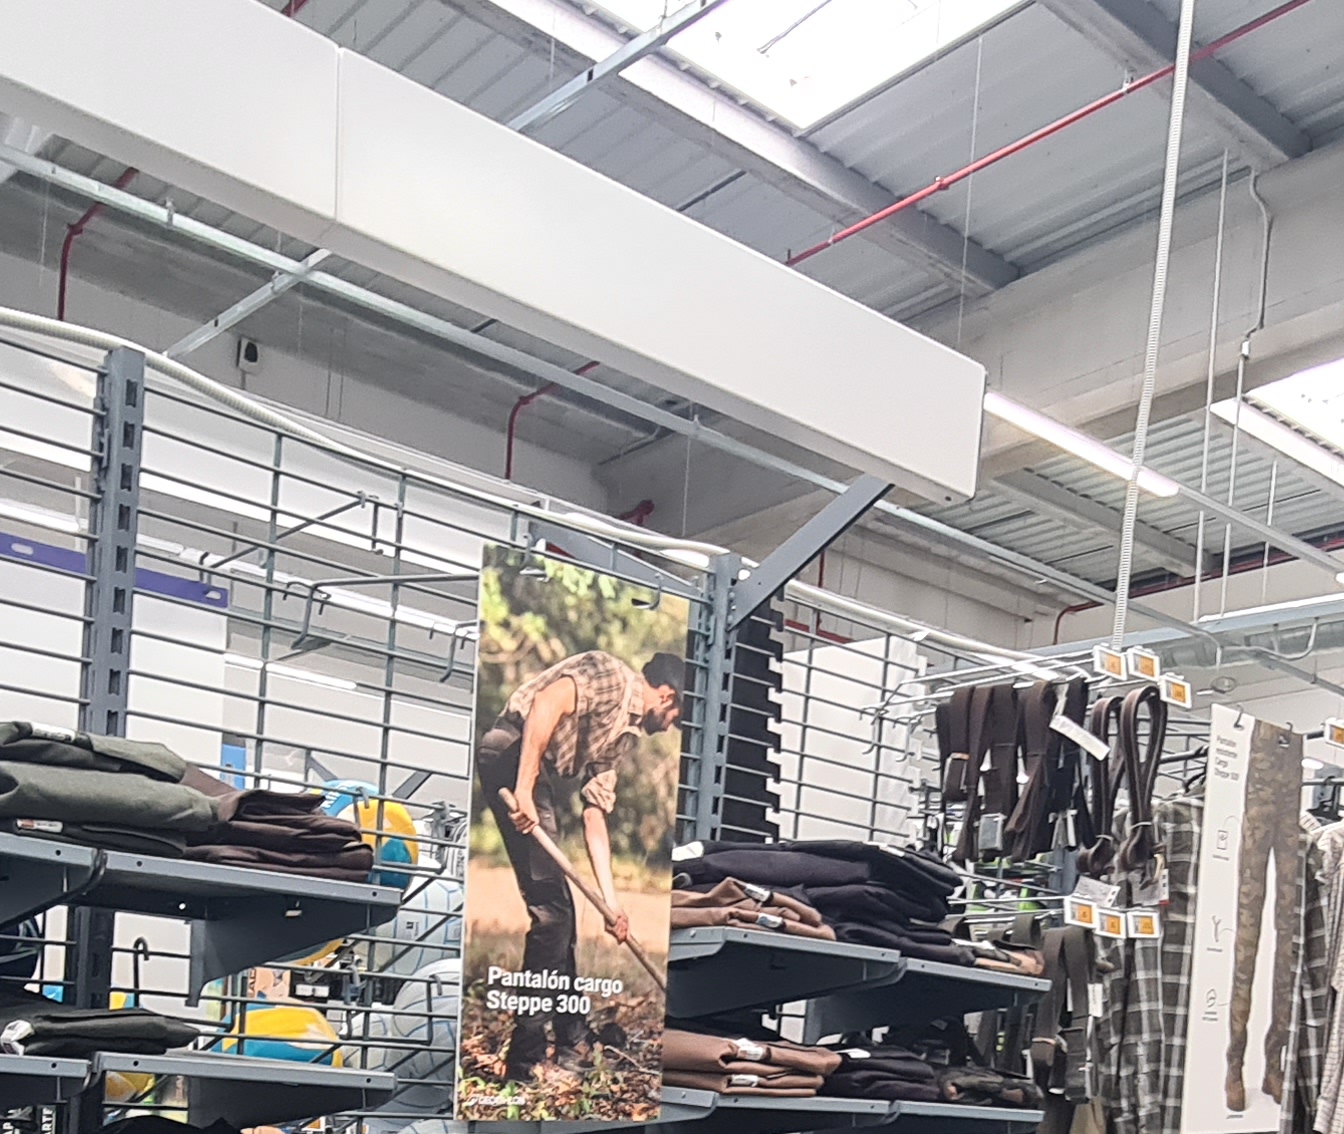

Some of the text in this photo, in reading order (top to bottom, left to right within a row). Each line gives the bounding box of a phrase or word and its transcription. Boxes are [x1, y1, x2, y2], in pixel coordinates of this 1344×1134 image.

[487, 966, 623, 998] Pantalón cargo
[486, 990, 591, 1016] Steppe 300
